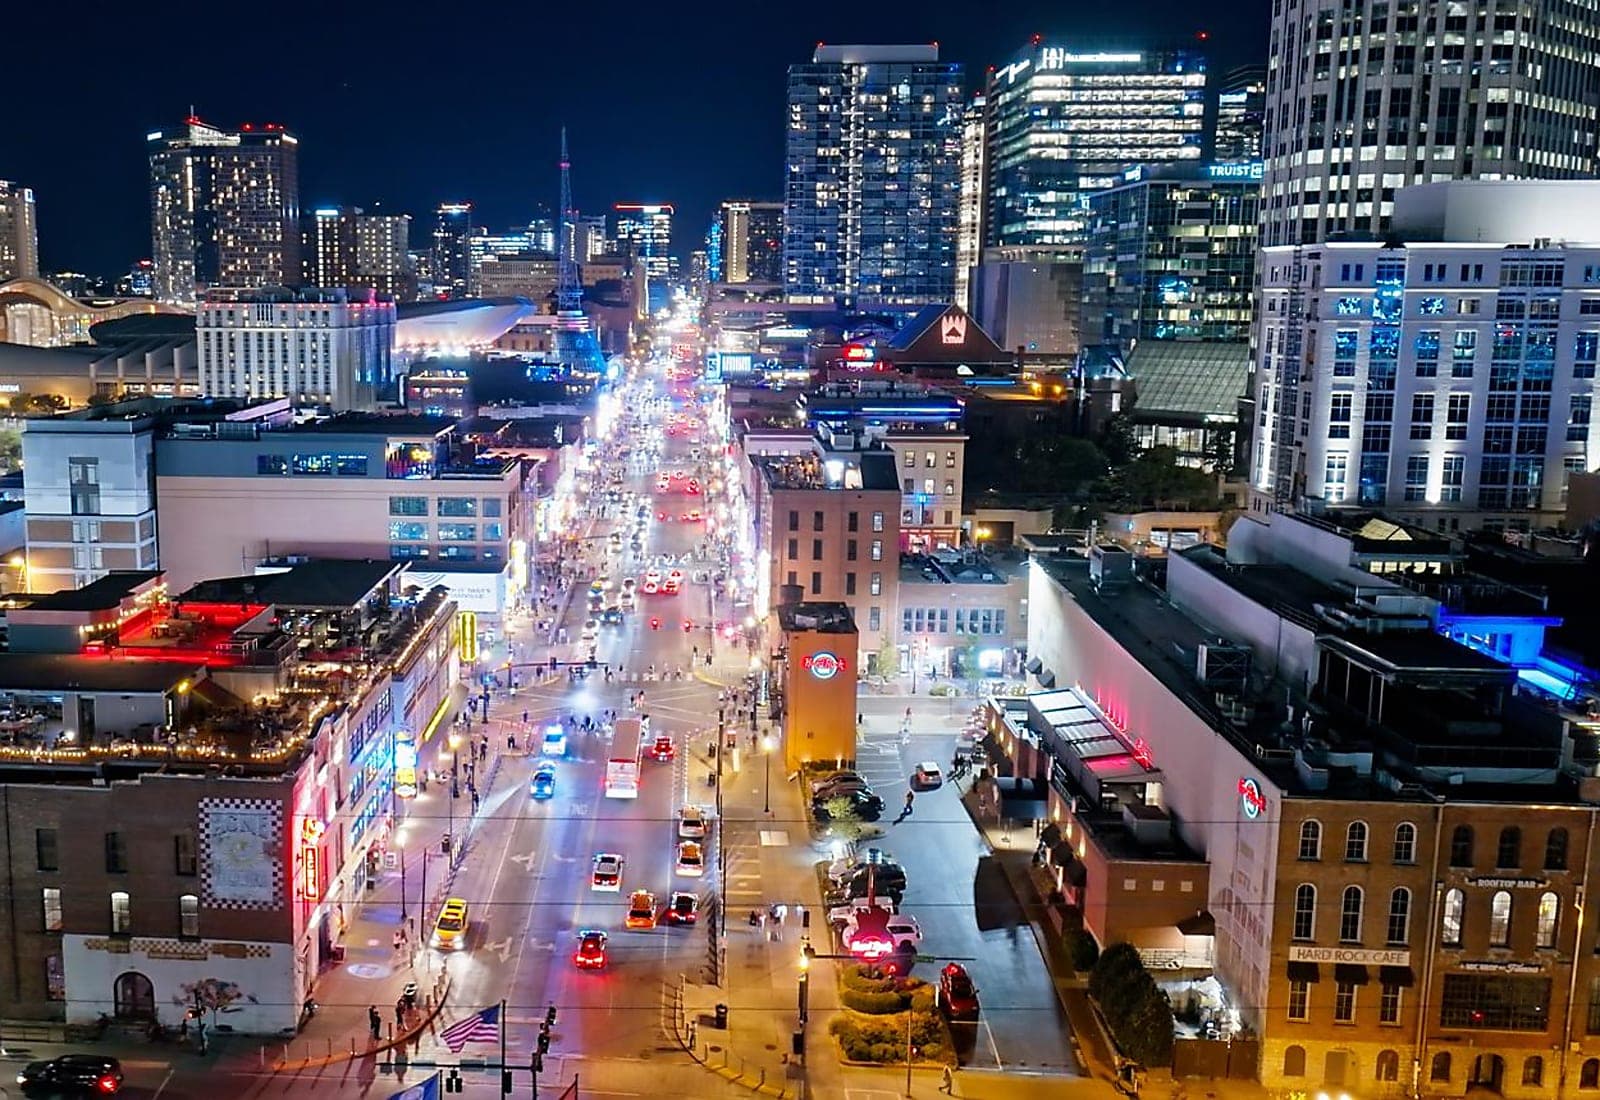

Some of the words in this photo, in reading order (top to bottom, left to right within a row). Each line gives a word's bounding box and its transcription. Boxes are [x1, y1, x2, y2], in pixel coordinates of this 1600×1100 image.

[1208, 165, 1250, 177] TRUIST
[1477, 879, 1516, 888] ROOFTOP
[1517, 880, 1537, 889] BAR
[1297, 948, 1331, 960] HARD
[1334, 950, 1369, 962] ROCK
[1372, 951, 1405, 963] CAFE
